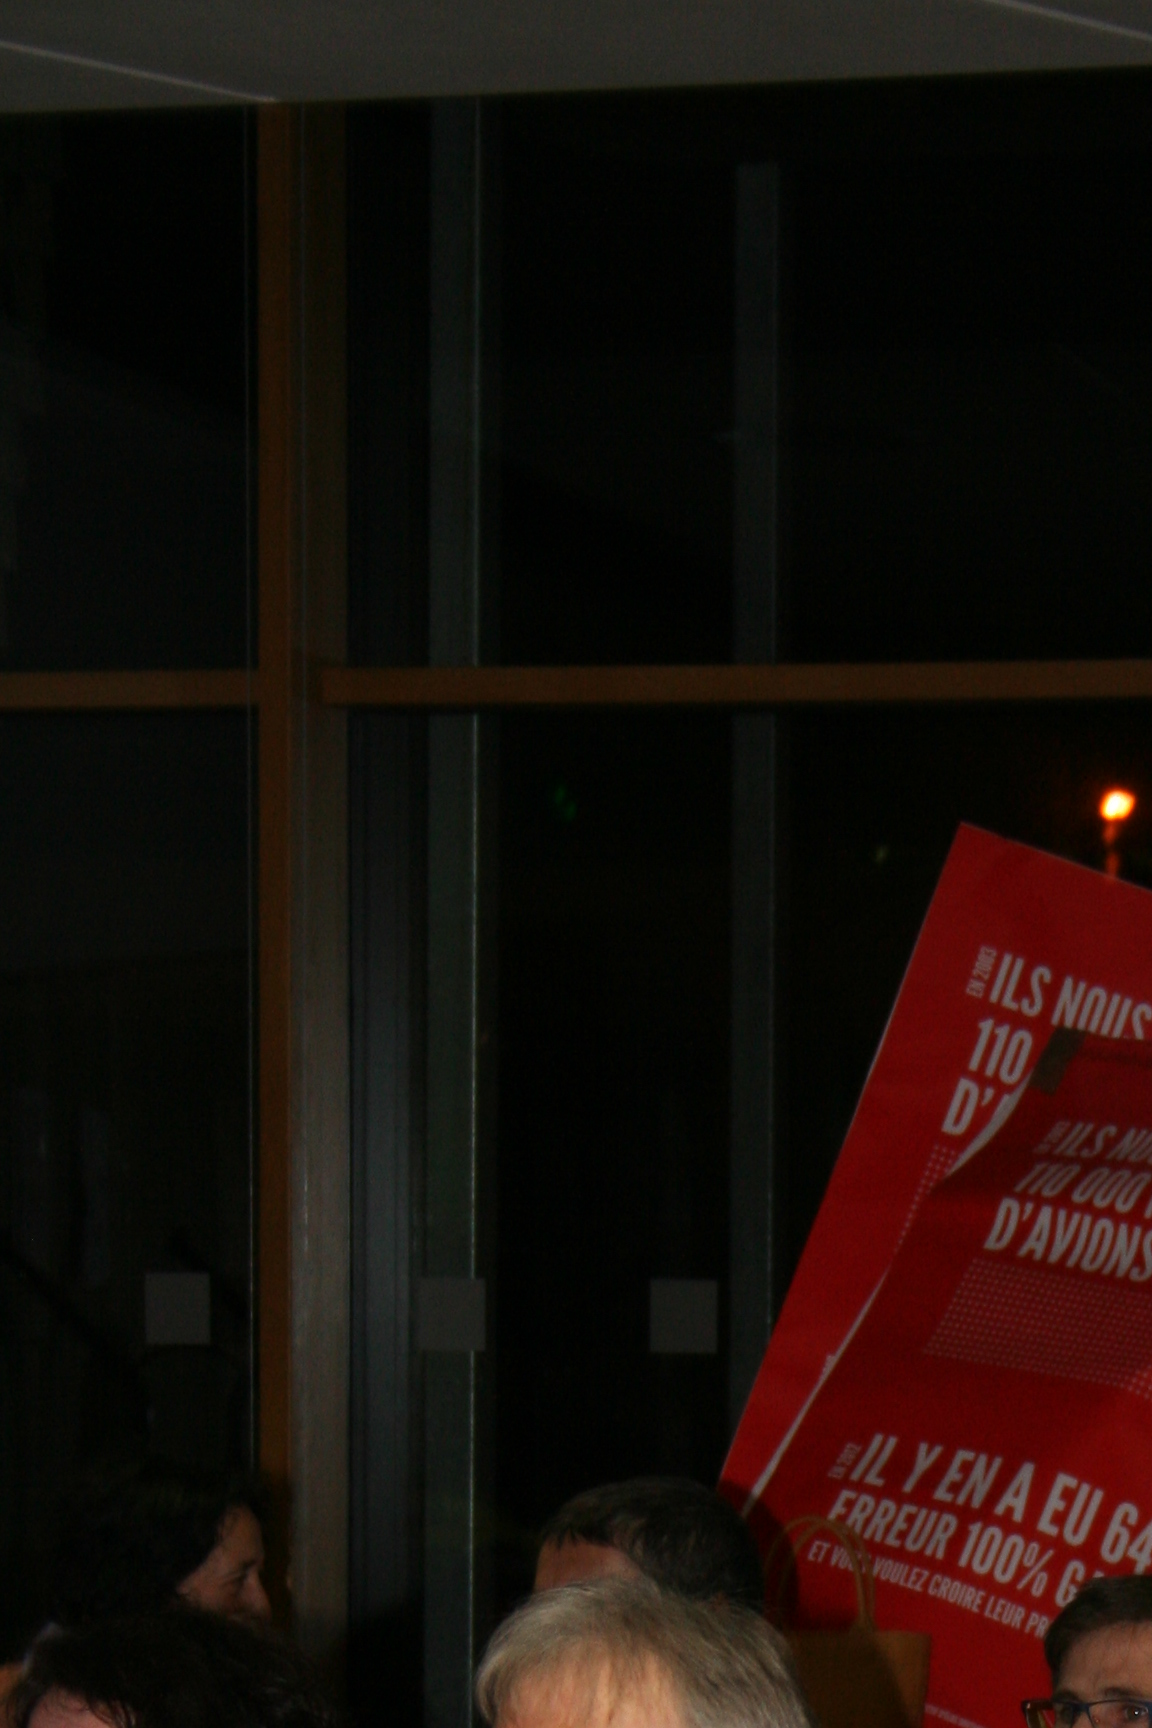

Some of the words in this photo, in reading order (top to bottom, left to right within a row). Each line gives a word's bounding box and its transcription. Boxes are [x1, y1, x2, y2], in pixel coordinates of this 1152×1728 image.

[989, 953, 1051, 1018] ILS
[1051, 975, 1152, 1041] NOUS
[968, 1017, 1034, 1085] 110
[1013, 1160, 1082, 1198] 110
[1052, 1120, 1118, 1158] ILS
[849, 1432, 900, 1487] IL
[902, 1440, 944, 1494] Y
[932, 1448, 1005, 1510] EN
[993, 1459, 1037, 1524] A
[1036, 1470, 1105, 1547] EU
[807, 1538, 832, 1563] ET
[872, 1555, 930, 1593] VOULEZ
[927, 1573, 987, 1613] CROIRE
[984, 1594, 1027, 1630] LEUR
[826, 1488, 959, 1561] ERREUR
[957, 1521, 1055, 1597] 100%
